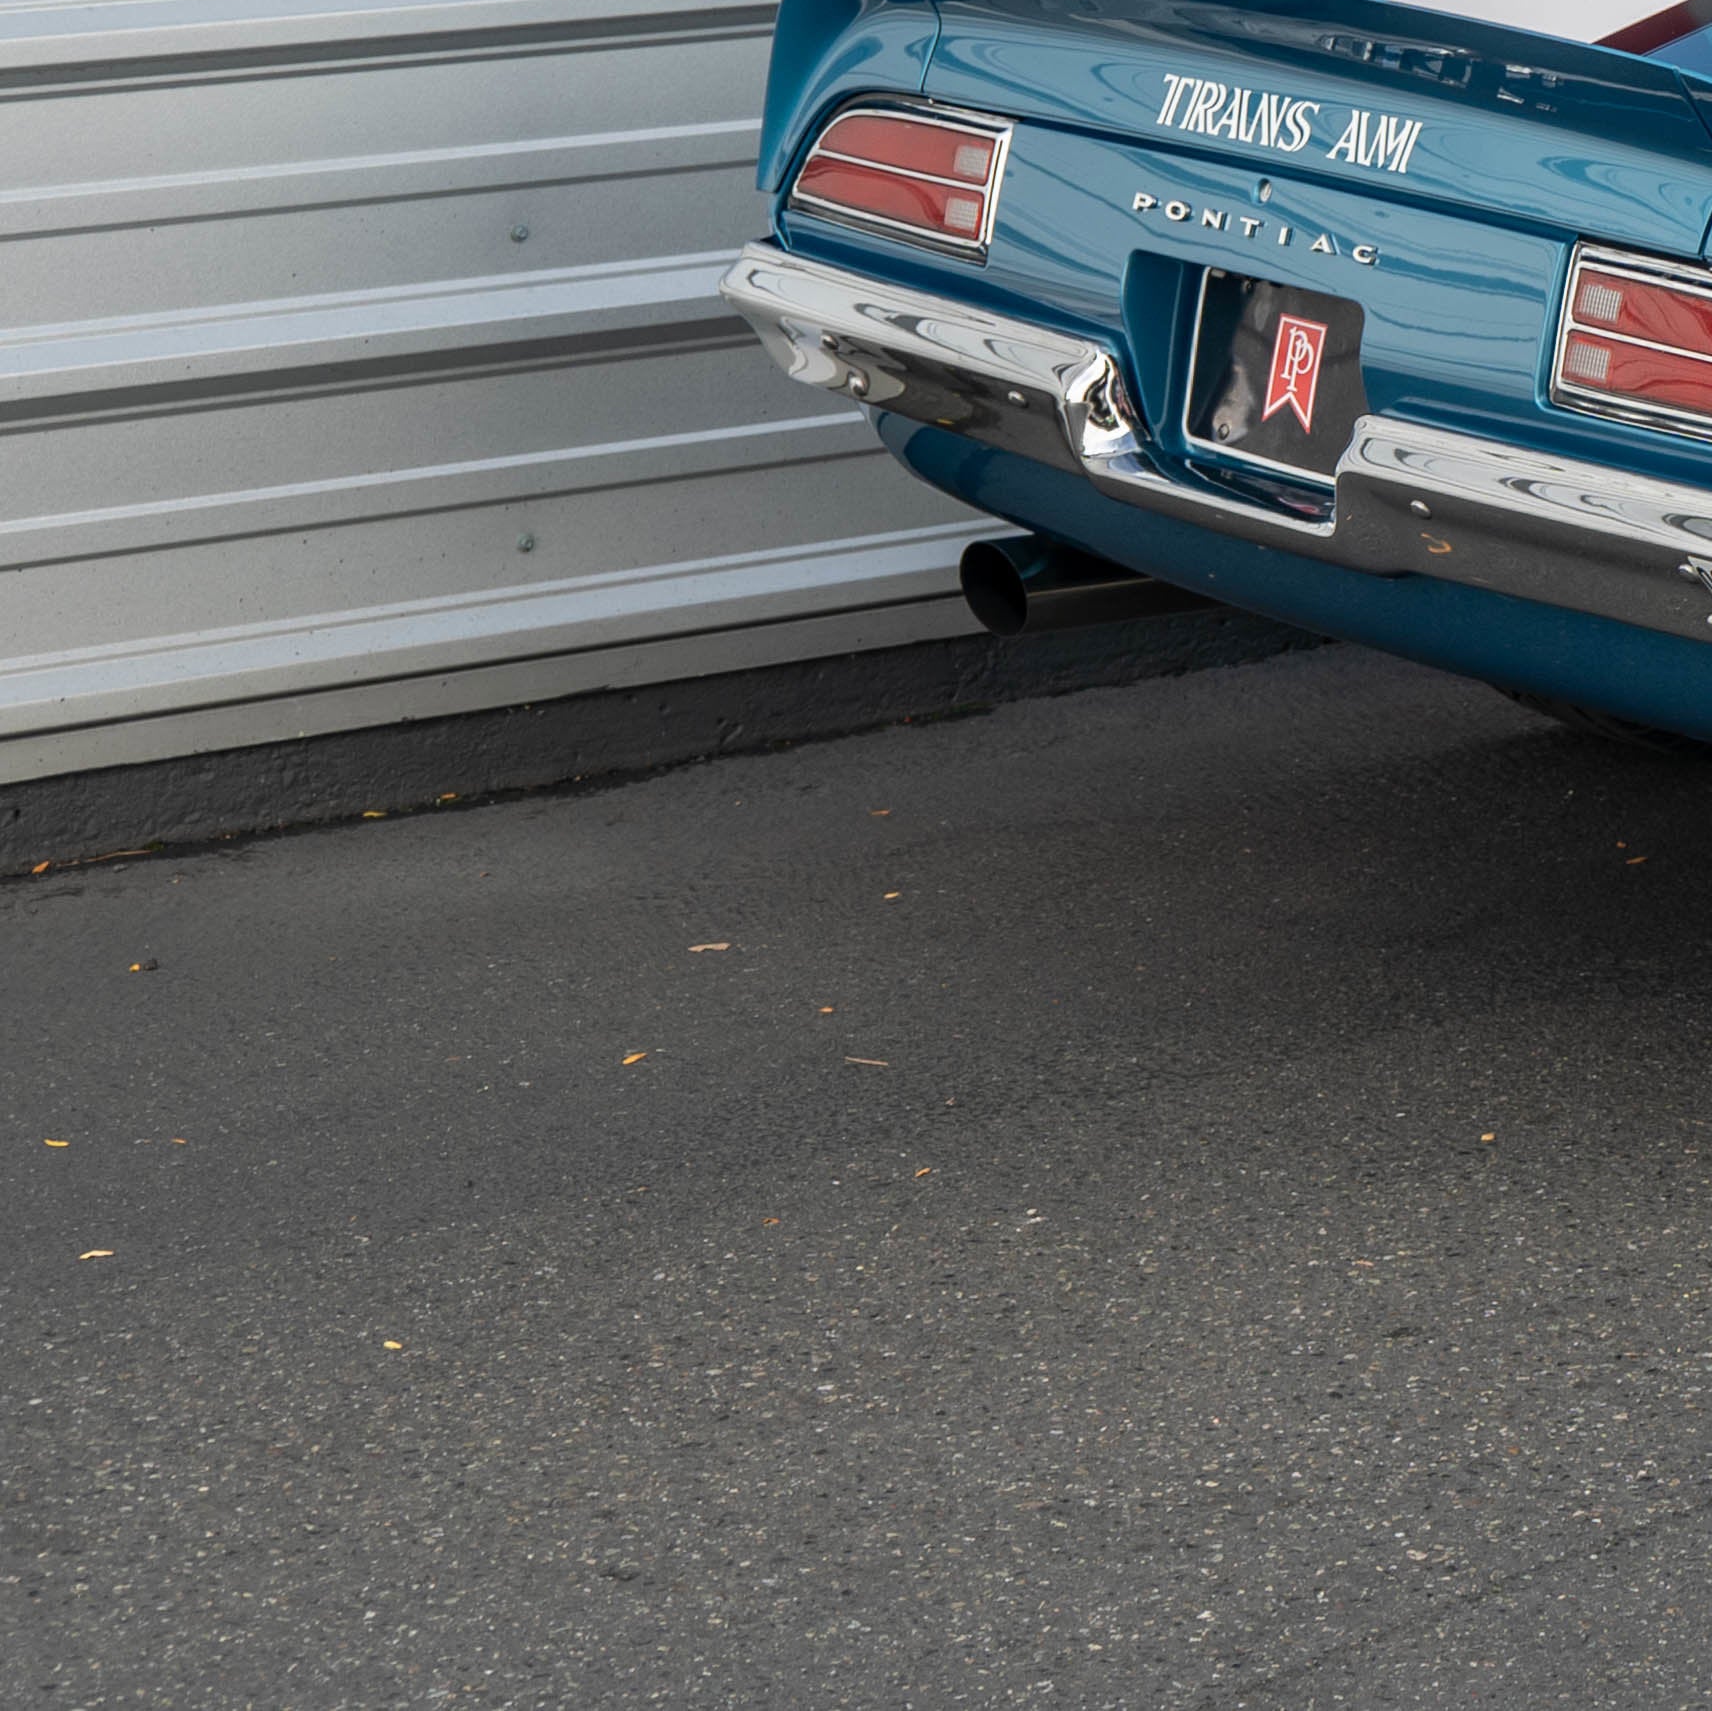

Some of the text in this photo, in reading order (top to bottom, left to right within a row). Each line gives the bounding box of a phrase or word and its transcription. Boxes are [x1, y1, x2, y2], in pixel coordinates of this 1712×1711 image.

[1156, 73, 1423, 174] TRANS AM
[1132, 191, 1379, 266] PONTIAC
